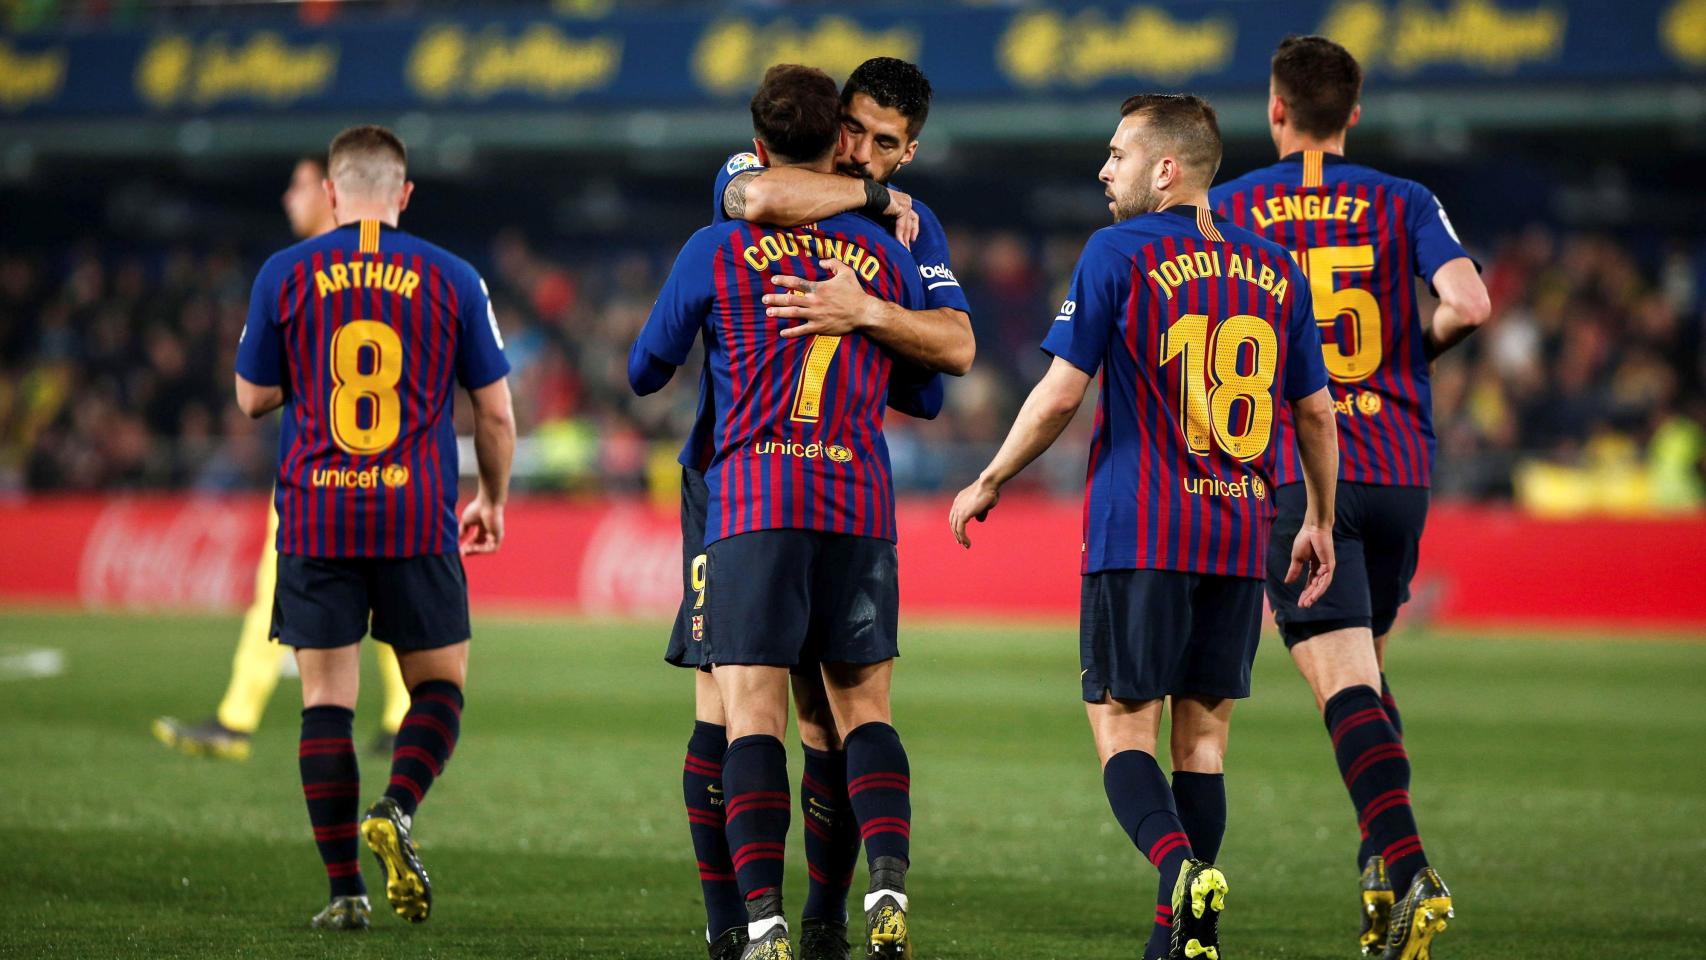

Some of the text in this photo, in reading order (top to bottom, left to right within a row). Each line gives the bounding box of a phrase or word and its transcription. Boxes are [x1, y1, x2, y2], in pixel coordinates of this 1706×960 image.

[1251, 194, 1370, 229] LENGLET
[313, 261, 420, 299] ARTHUR
[743, 232, 880, 282] COUTINHO
[1148, 250, 1289, 306] JORDI ALBA
[1290, 244, 1383, 384] 5
[329, 319, 404, 456] 8
[1159, 313, 1279, 463] 18
[312, 465, 380, 489] unicef
[1183, 474, 1250, 498] unicef
[690, 553, 708, 610] 9
